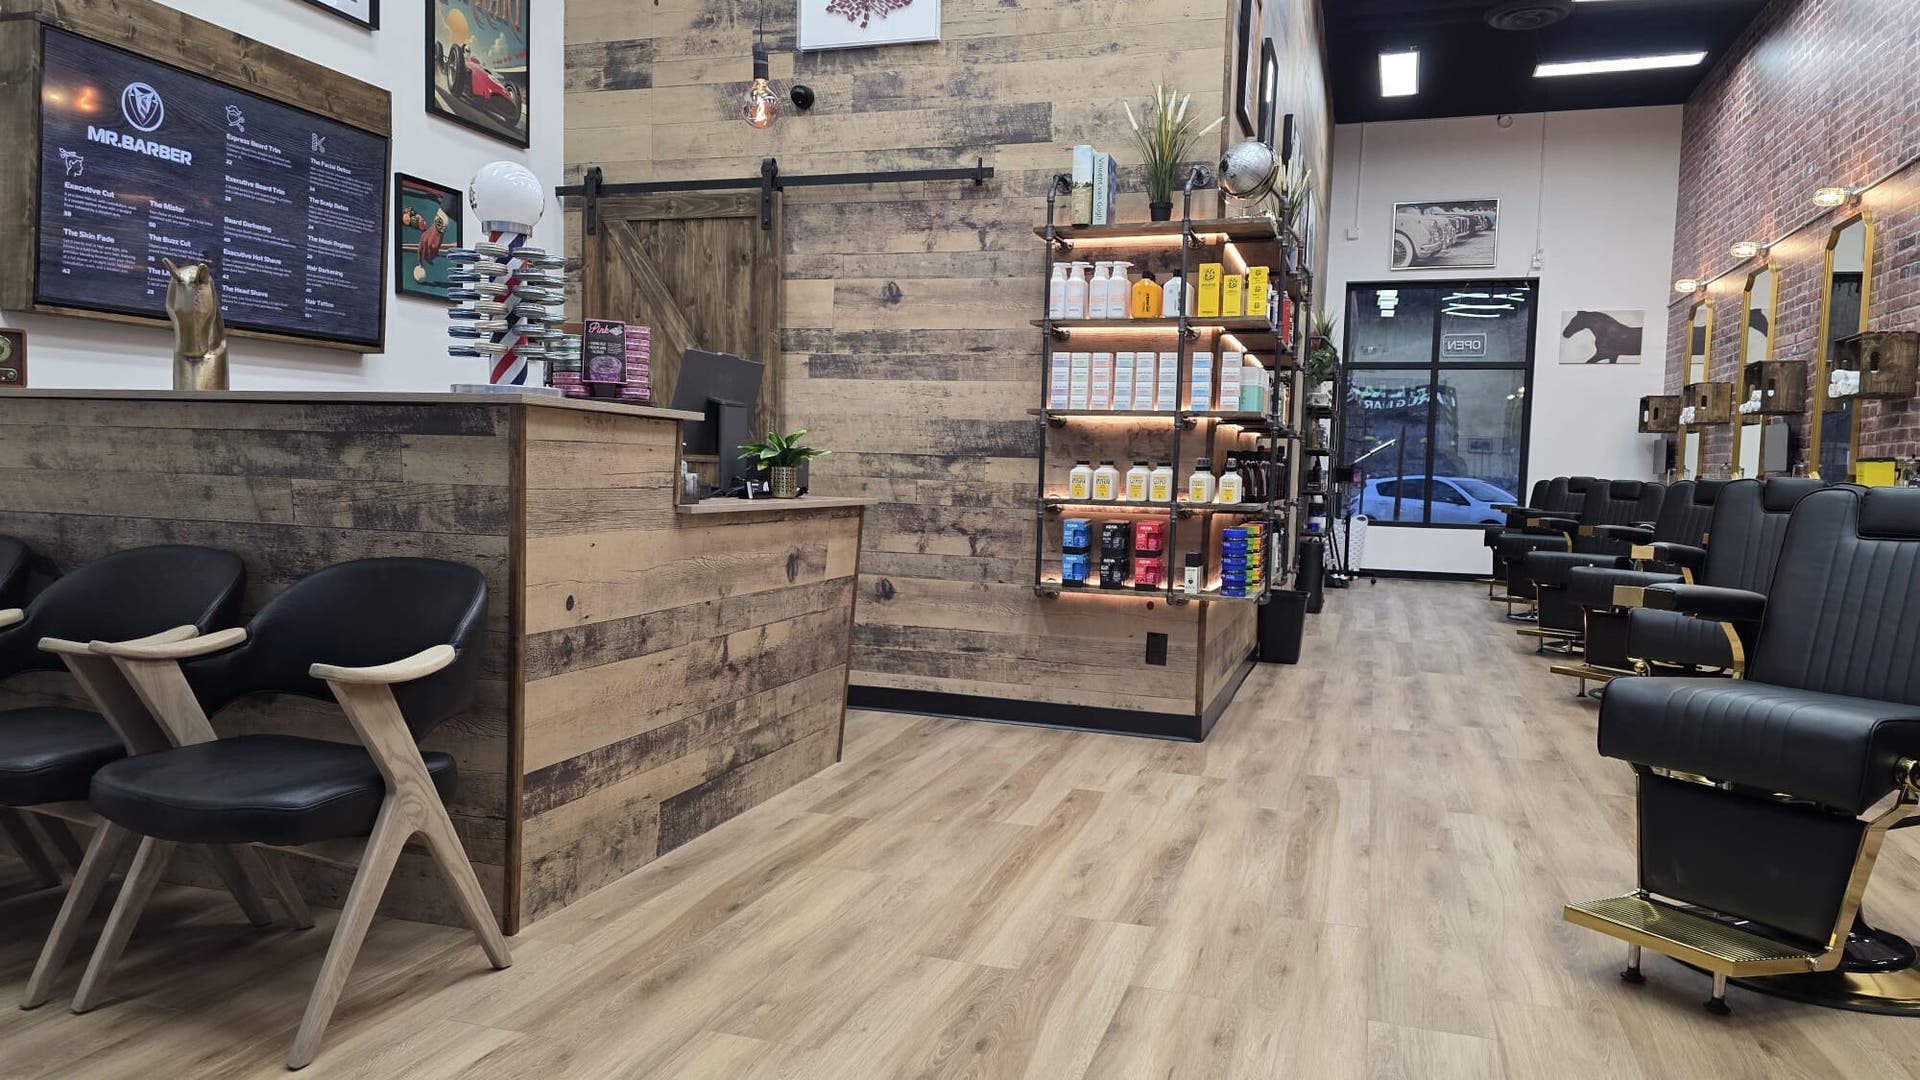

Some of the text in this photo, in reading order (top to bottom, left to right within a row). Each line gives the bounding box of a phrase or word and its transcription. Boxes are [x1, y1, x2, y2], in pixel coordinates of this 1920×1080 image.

[88, 125, 192, 165] MR.BARBER
[250, 140, 268, 150] Beard
[310, 158, 320, 166] The
[64, 181, 115, 198] Executive Cut
[225, 175, 254, 187] Executive
[255, 183, 272, 192] Beard
[149, 200, 185, 213] The Mister
[309, 196, 319, 204] The
[1096, 201, 1104, 220] Gogh
[224, 216, 242, 226] Beard
[63, 228, 115, 243] The Skin Fade
[148, 234, 191, 247] The Buzz Cut
[223, 248, 252, 259] Executive
[148, 267, 161, 275] The
[222, 284, 234, 292] The
[250, 289, 268, 297] Shave
[588, 322, 610, 334] Pink
